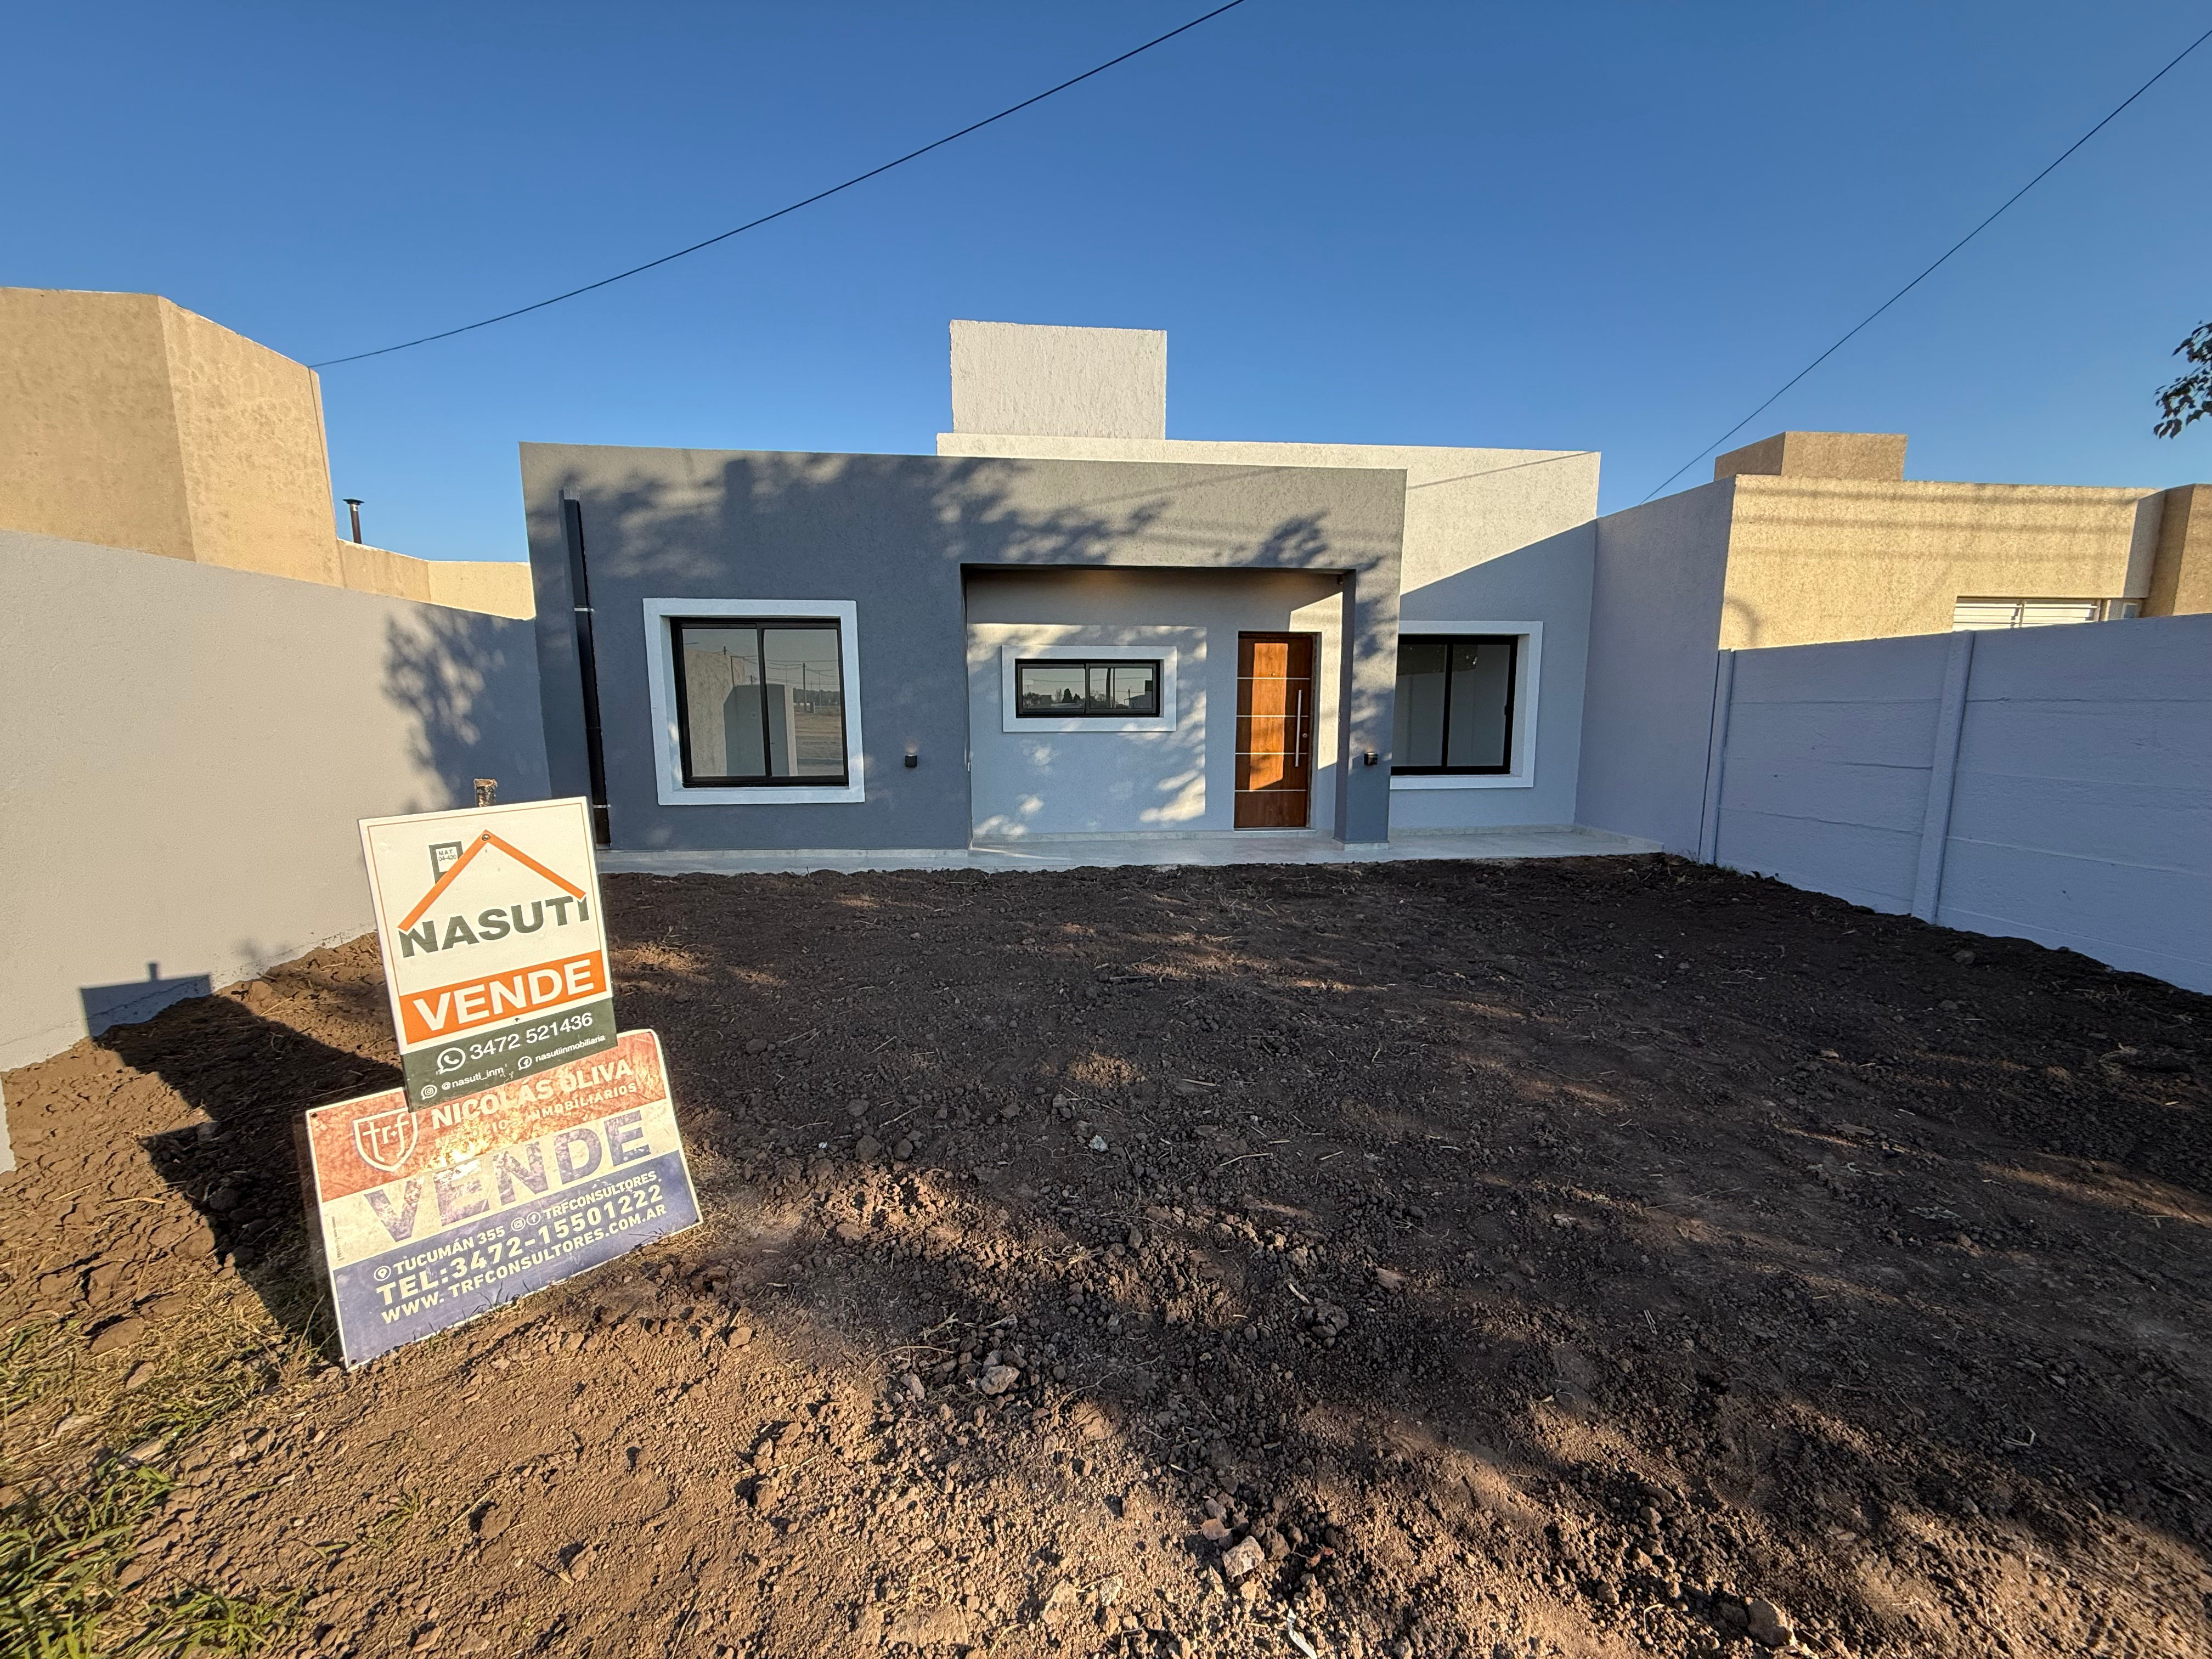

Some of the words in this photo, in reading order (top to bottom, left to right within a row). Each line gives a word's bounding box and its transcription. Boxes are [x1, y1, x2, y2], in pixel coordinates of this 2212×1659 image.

[398, 895, 589, 958] NASUTI
[413, 959, 594, 1031] VENDE
[470, 1034, 521, 1060] 3472
[526, 1012, 593, 1043] 521436
[535, 1034, 606, 1062] nasutiinmobiliaria
[431, 1078, 554, 1130] NICOLÁS
[561, 1058, 633, 1093] OLIVA
[442, 1066, 504, 1091] @nasuti_inm
[364, 1110, 651, 1243] VENDE
[543, 1171, 657, 1220] TRFCONSULTORES
[393, 1237, 475, 1274] TUCUMÁN
[477, 1225, 505, 1244] 355
